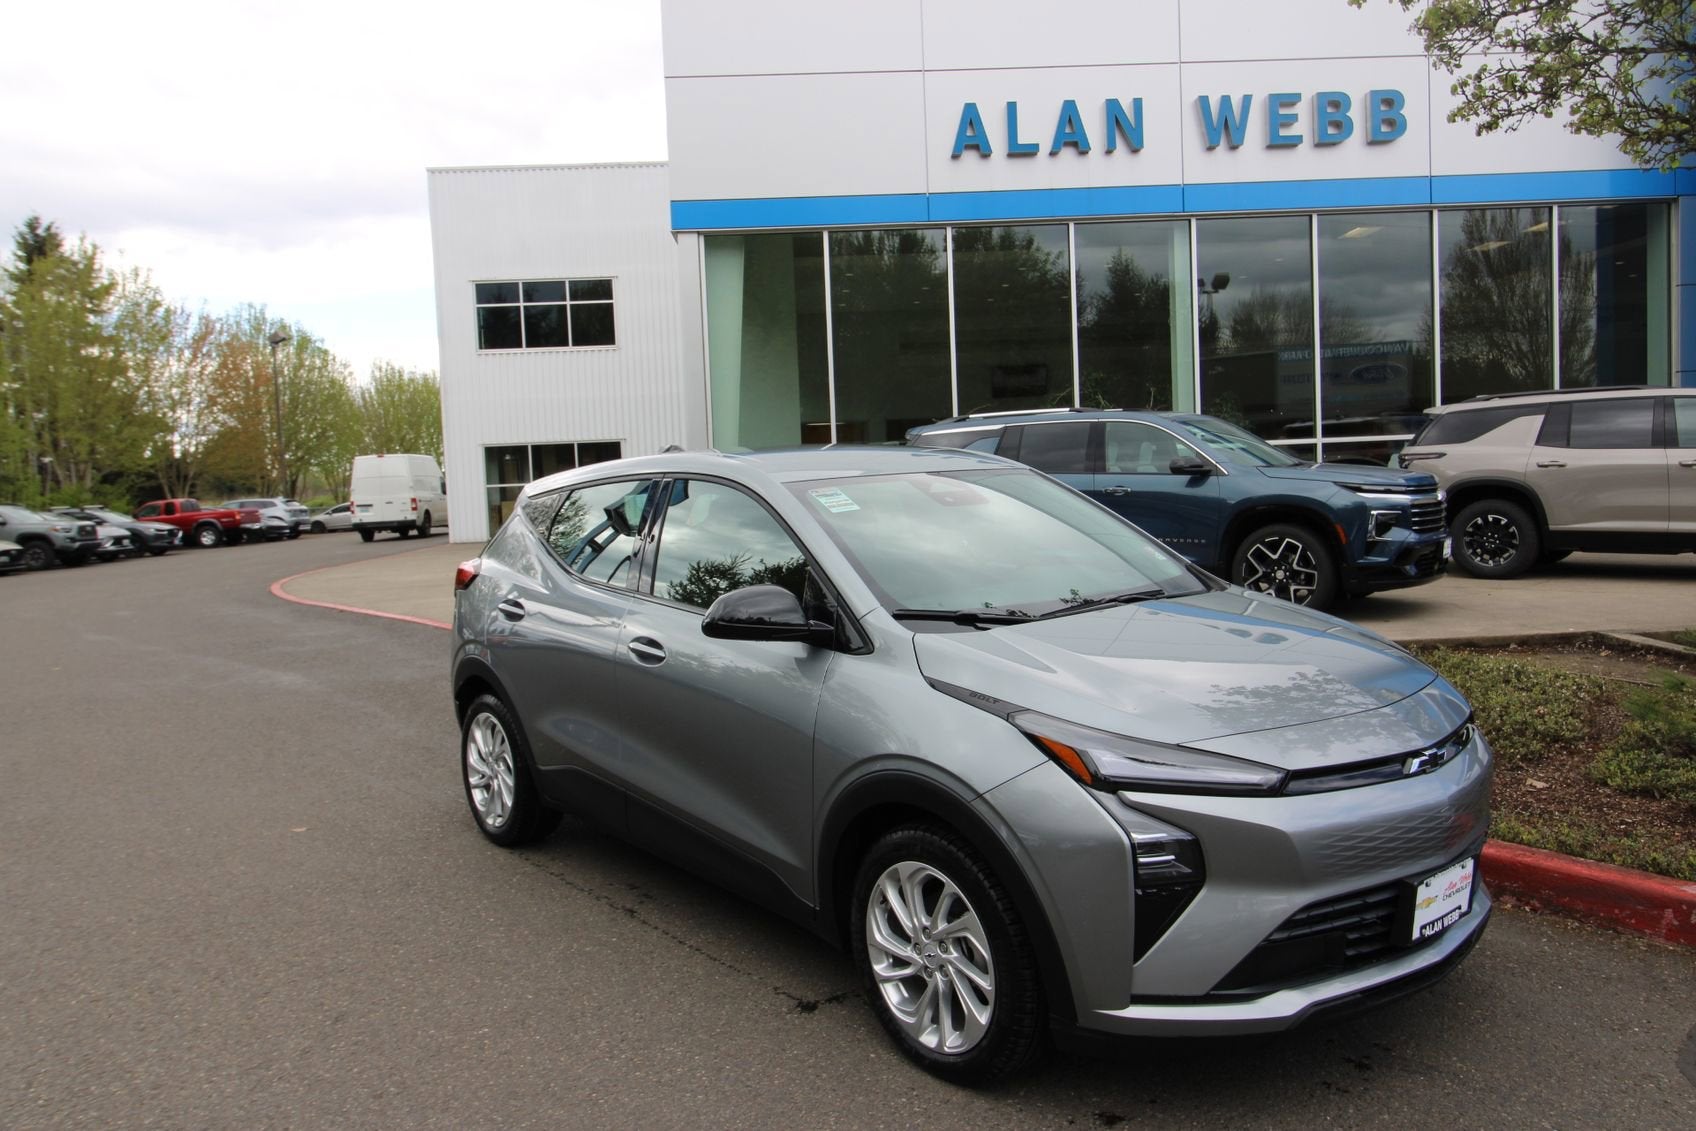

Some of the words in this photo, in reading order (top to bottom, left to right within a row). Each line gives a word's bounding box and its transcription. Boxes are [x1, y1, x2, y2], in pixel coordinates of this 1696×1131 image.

[951, 97, 1144, 159] ALAN
[1197, 88, 1407, 151] WEBB
[969, 691, 1001, 704] BOLT
[1442, 882, 1471, 901] CHEVROLET
[1425, 918, 1443, 937] ALAN
[1443, 908, 1460, 928] WEBB
